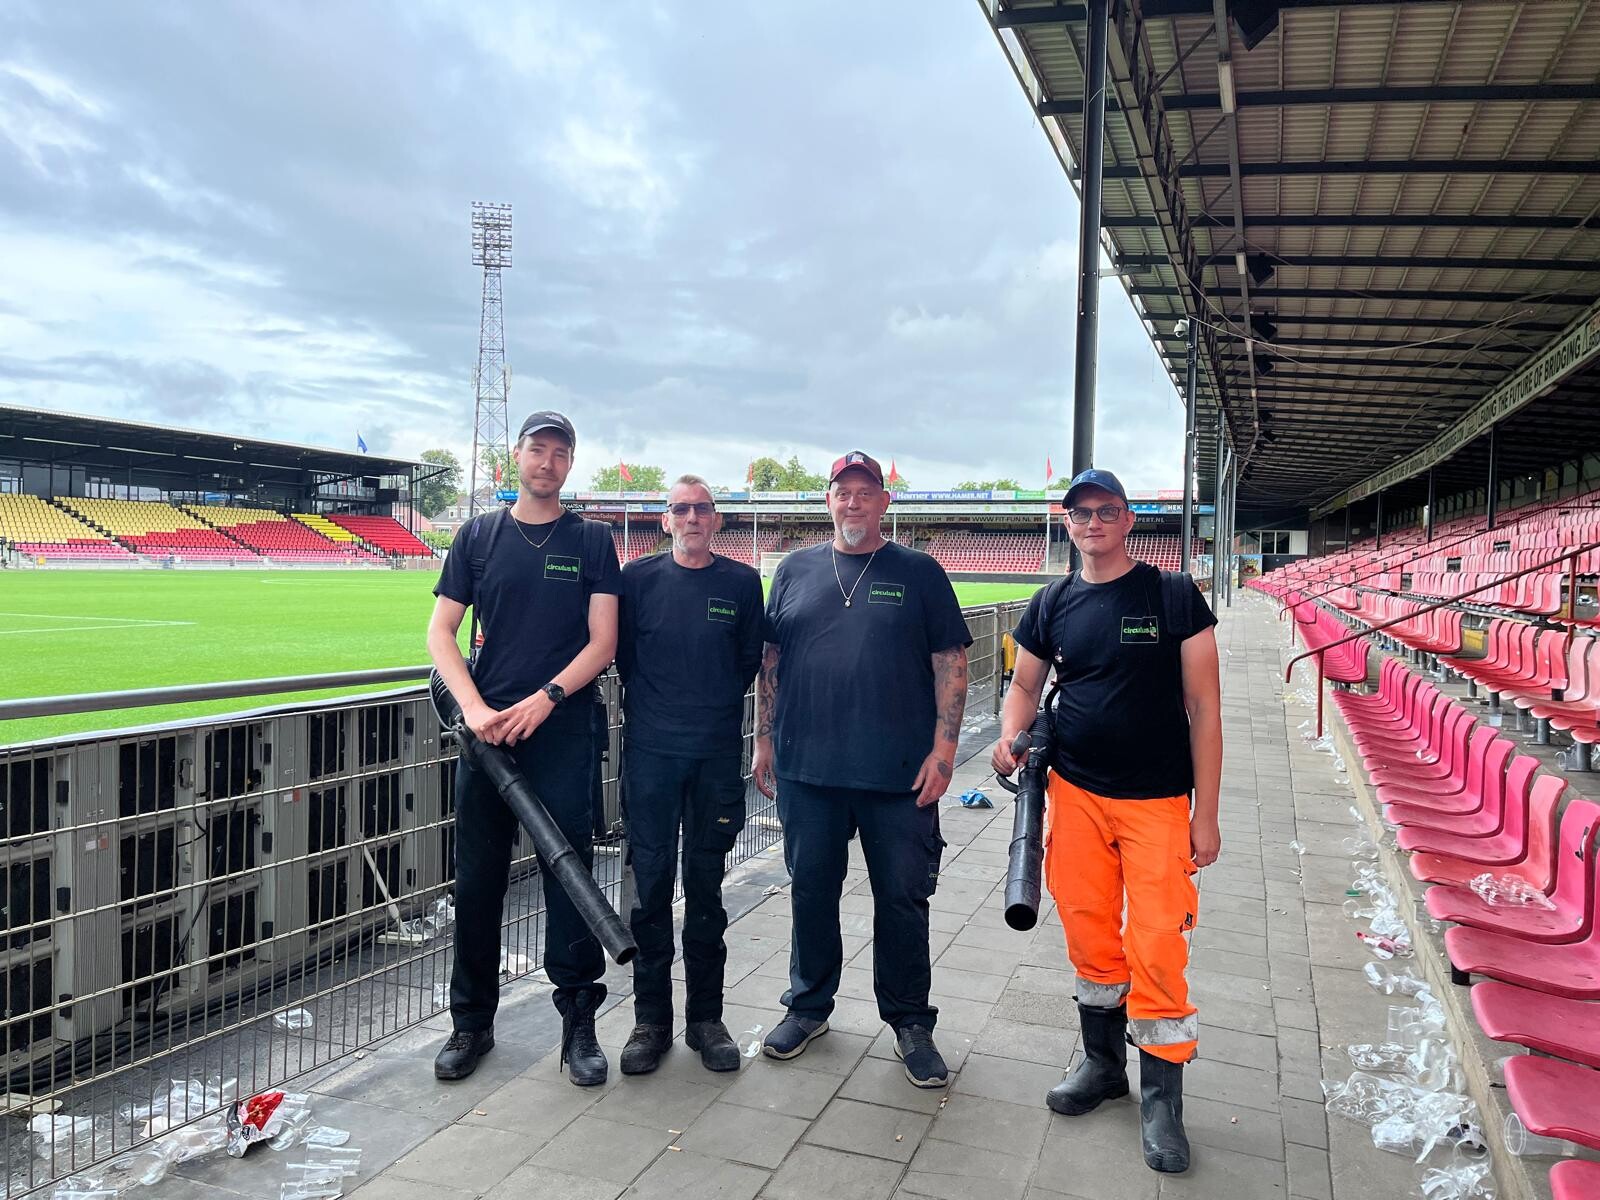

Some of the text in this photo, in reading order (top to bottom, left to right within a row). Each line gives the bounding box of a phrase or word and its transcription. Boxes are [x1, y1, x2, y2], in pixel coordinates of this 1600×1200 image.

[1498, 390, 1509, 413] THE
[1509, 372, 1533, 406] FUTURE
[1534, 364, 1543, 388] OF
[1544, 334, 1581, 382] BRIDGING
[546, 563, 572, 572] circulus
[871, 589, 896, 598] circulus
[709, 606, 731, 615] circulus
[1123, 626, 1150, 635] circulus
